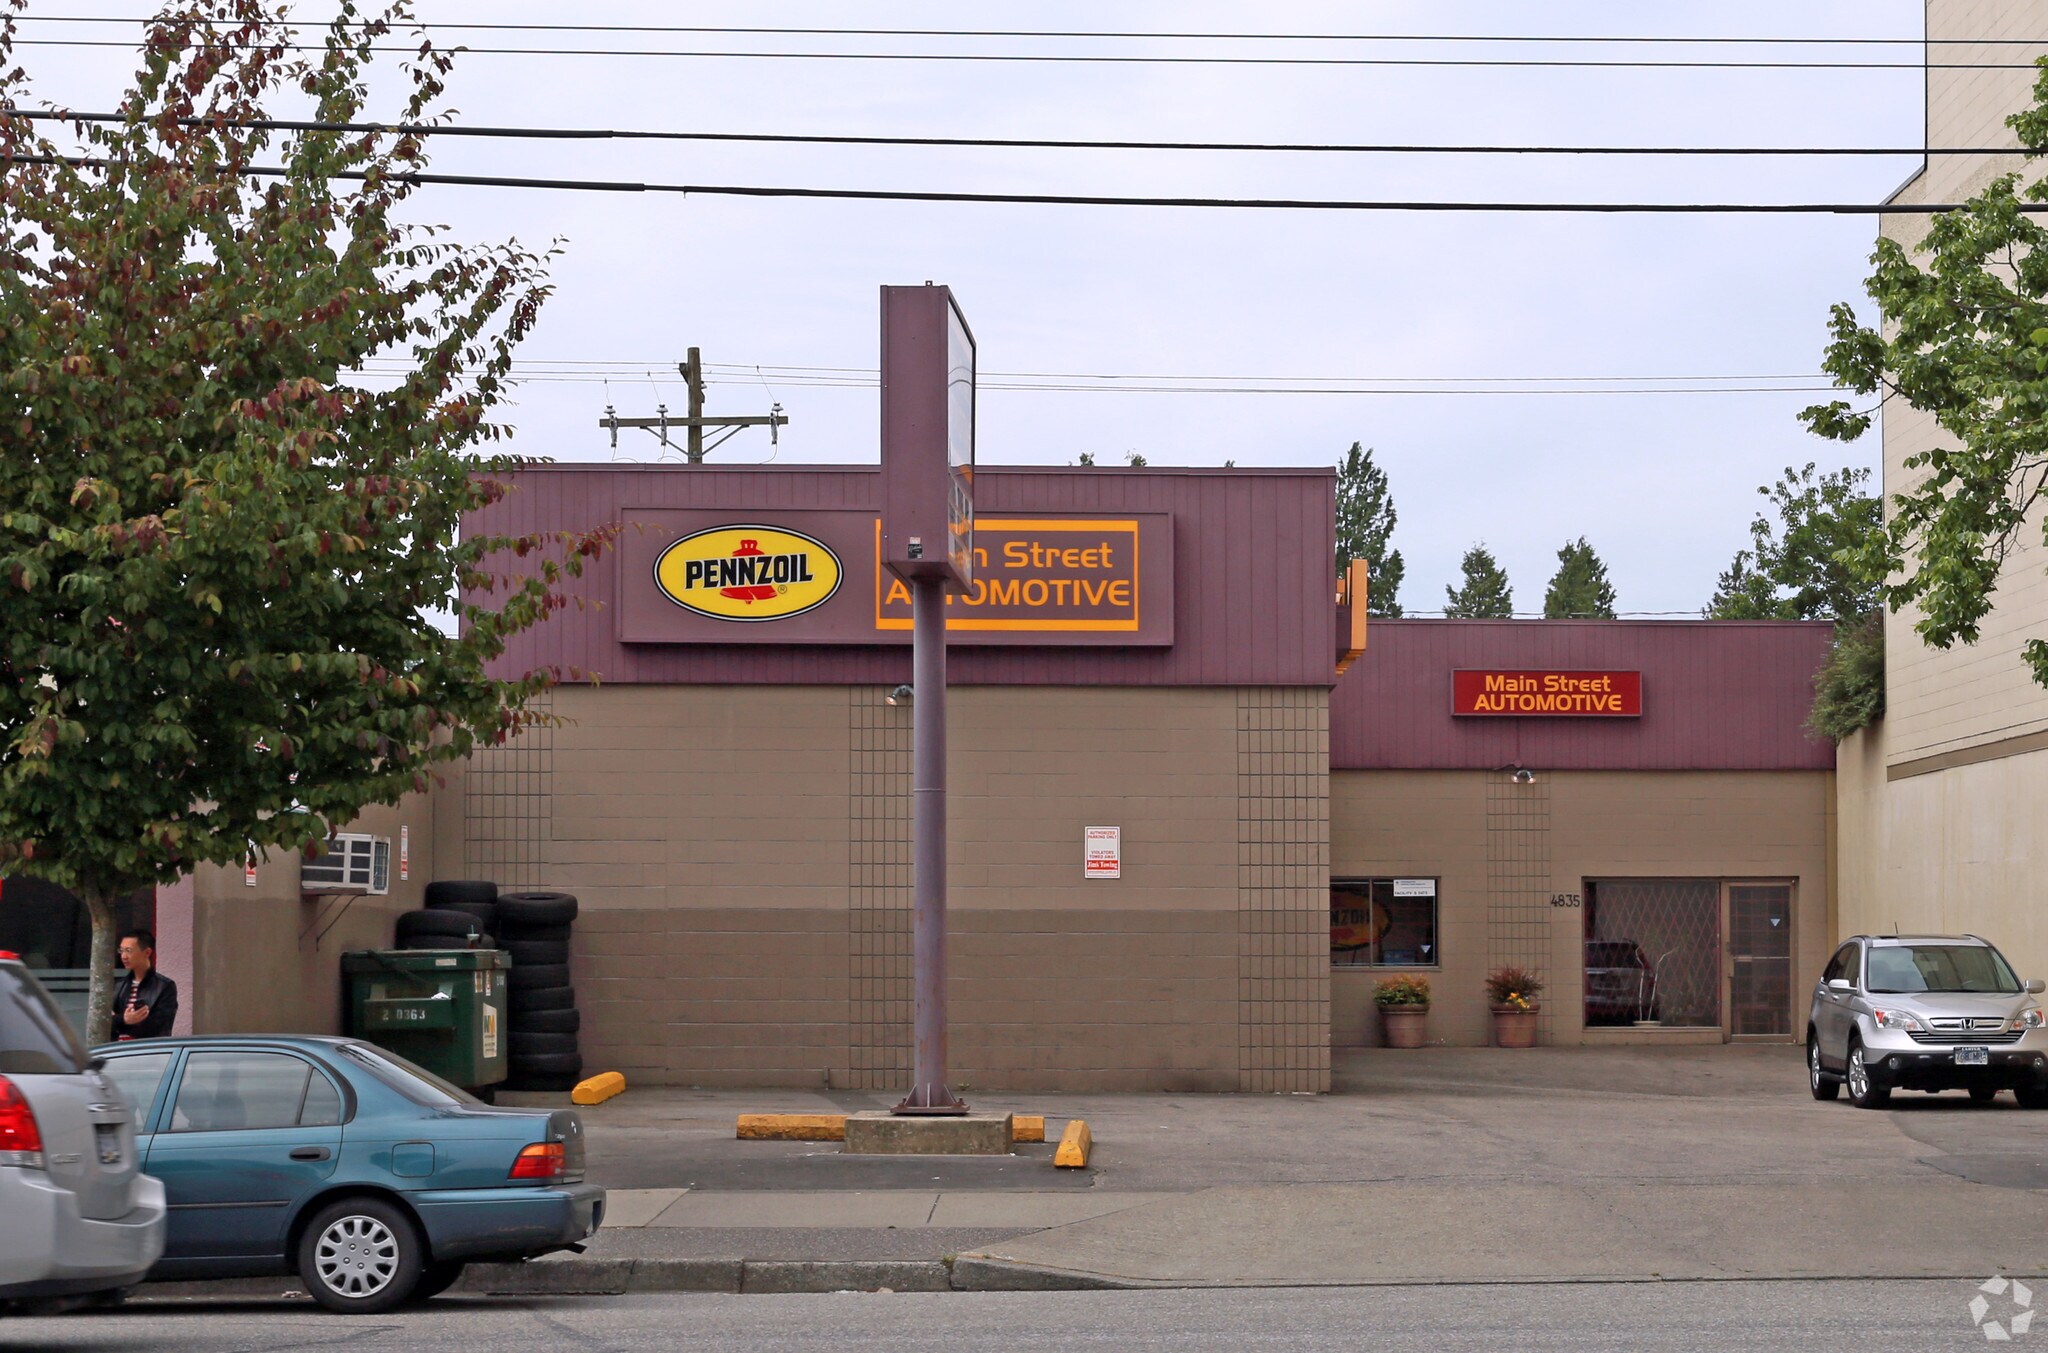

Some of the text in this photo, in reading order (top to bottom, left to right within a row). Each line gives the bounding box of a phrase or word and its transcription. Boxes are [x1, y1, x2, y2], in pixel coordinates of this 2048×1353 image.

[1003, 541, 1114, 568] Street
[685, 553, 814, 590] PENNZOIL
[885, 579, 1131, 607] AOMOTIVE
[1485, 675, 1612, 693] Main Street
[1473, 694, 1622, 712] AUTOMOTIVE
[1100, 861, 1118, 869] Towing
[1550, 893, 1581, 908] 4835
